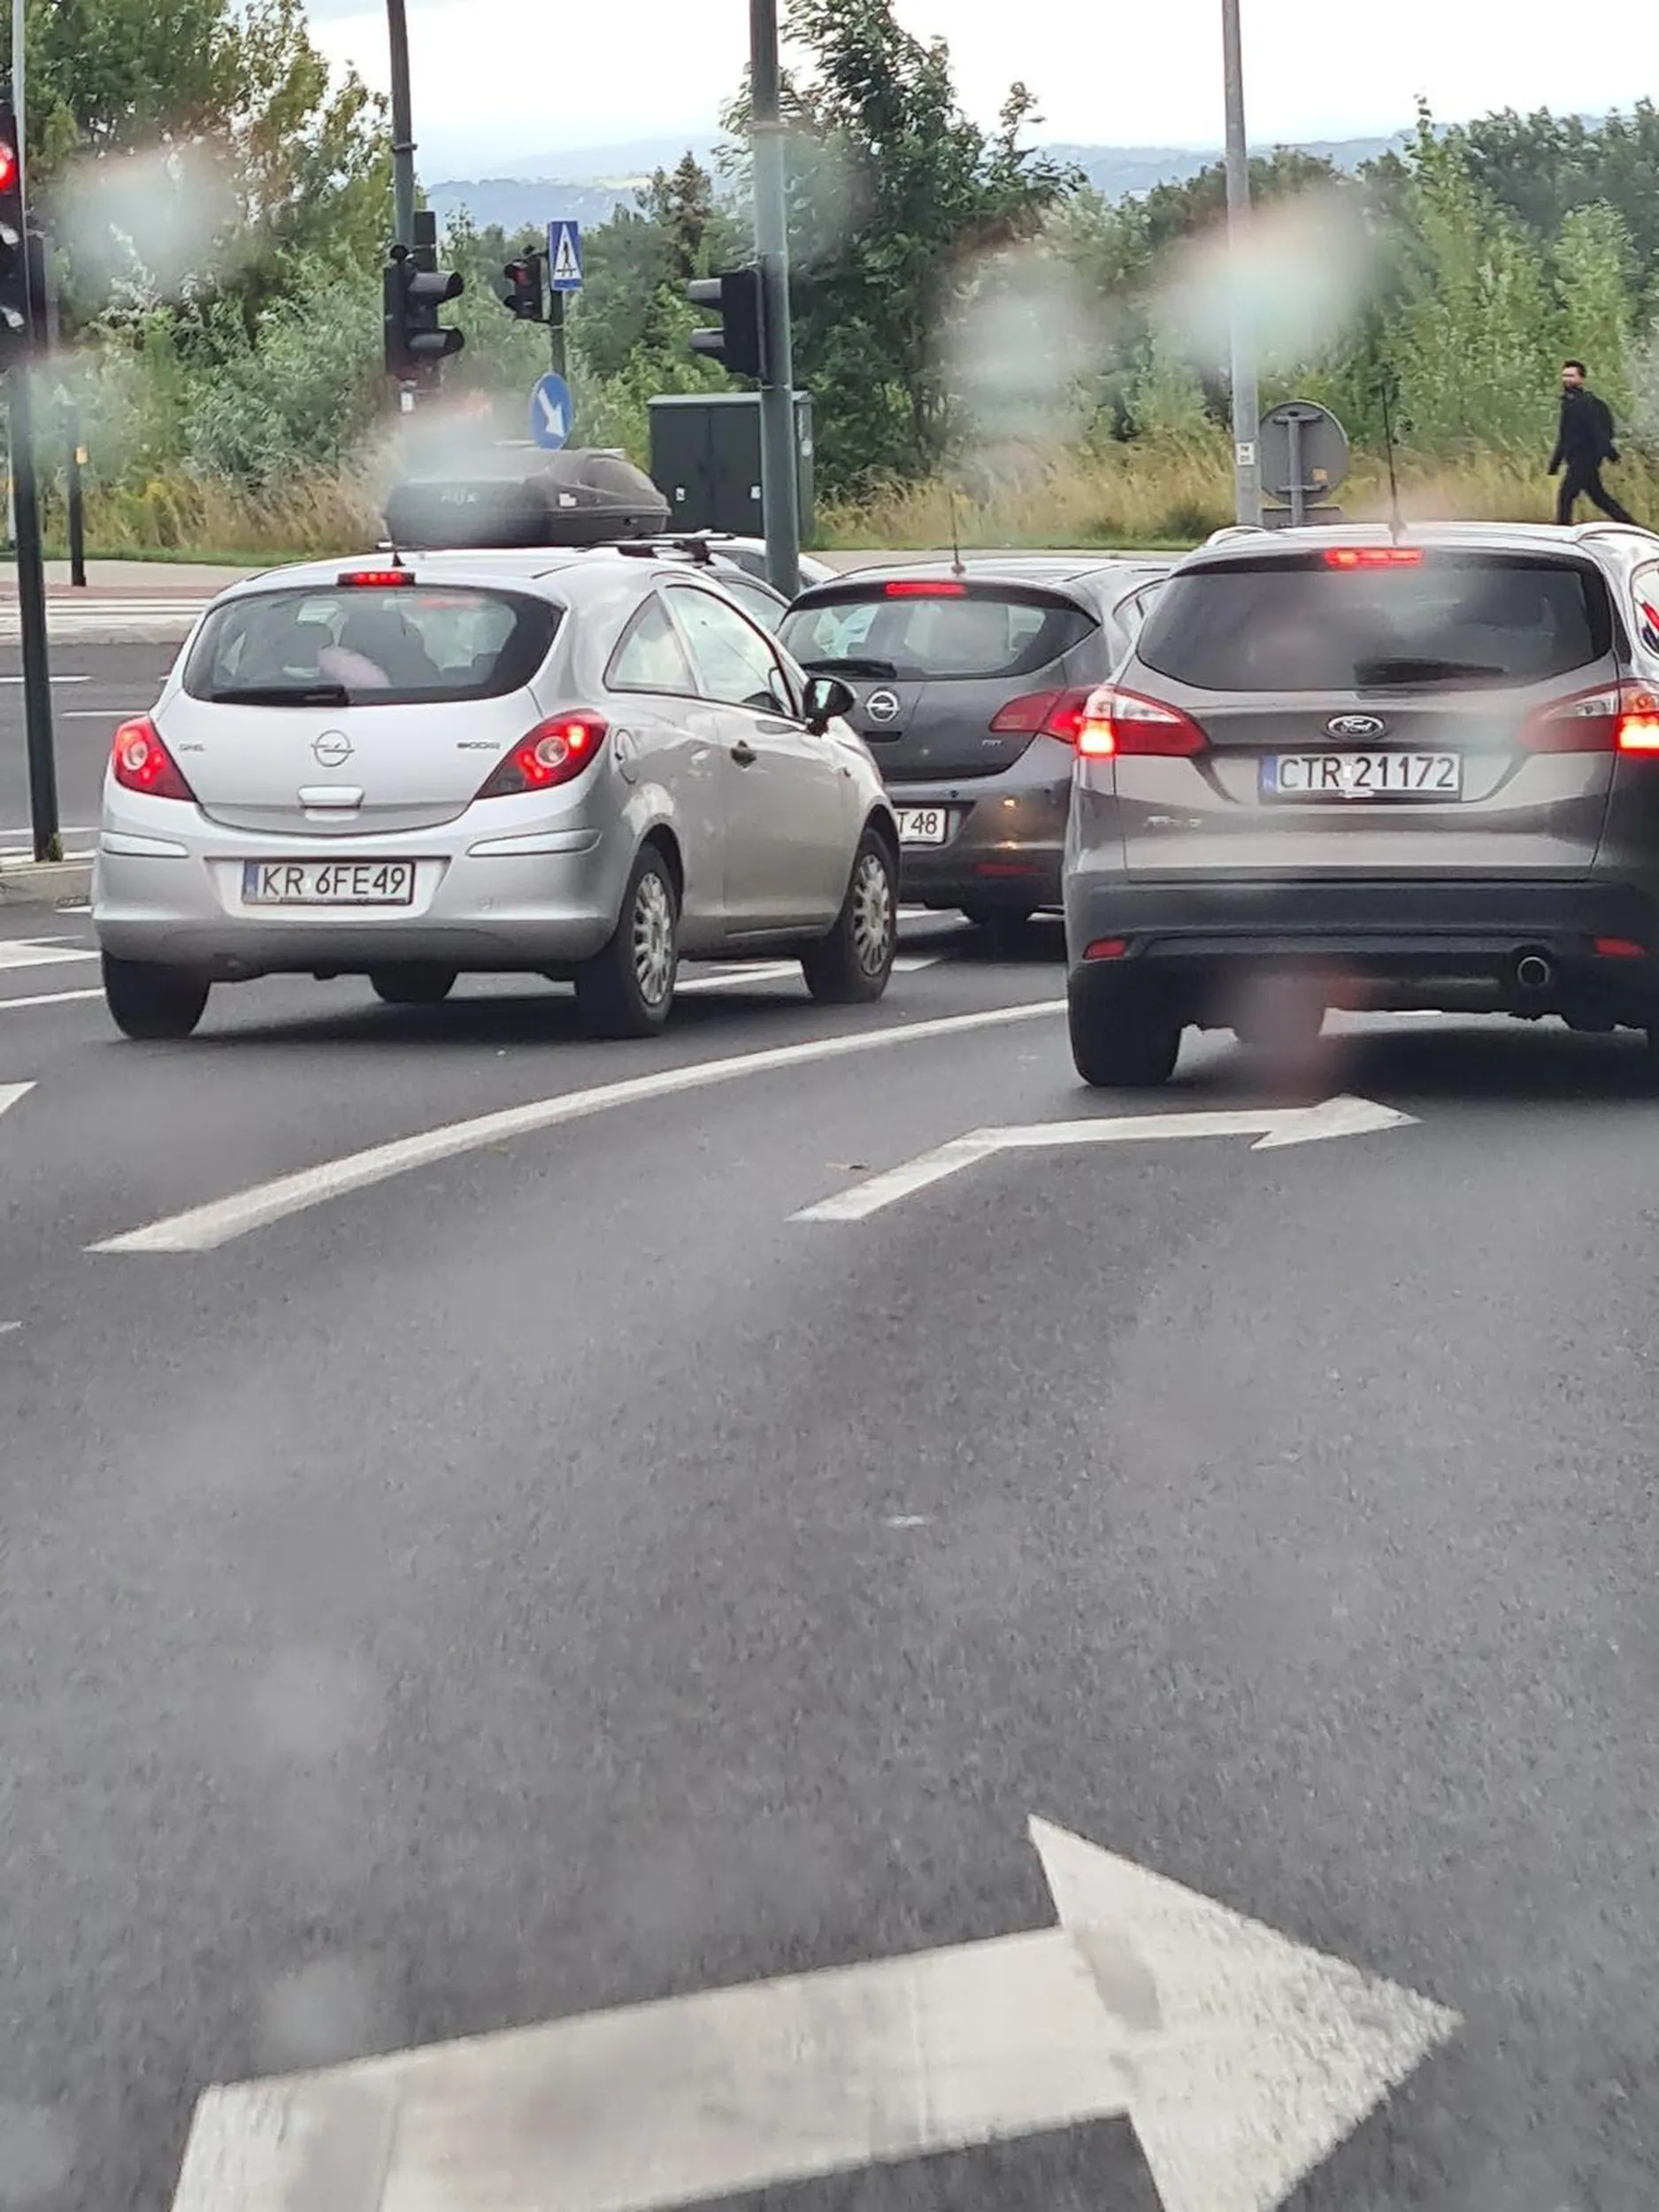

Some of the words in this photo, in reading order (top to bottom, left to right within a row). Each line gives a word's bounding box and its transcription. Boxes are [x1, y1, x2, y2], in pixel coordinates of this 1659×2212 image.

[1279, 757, 1341, 788] CTR
[1353, 756, 1454, 787] 21172
[263, 866, 304, 895] KR
[315, 865, 406, 895] 6FE49
